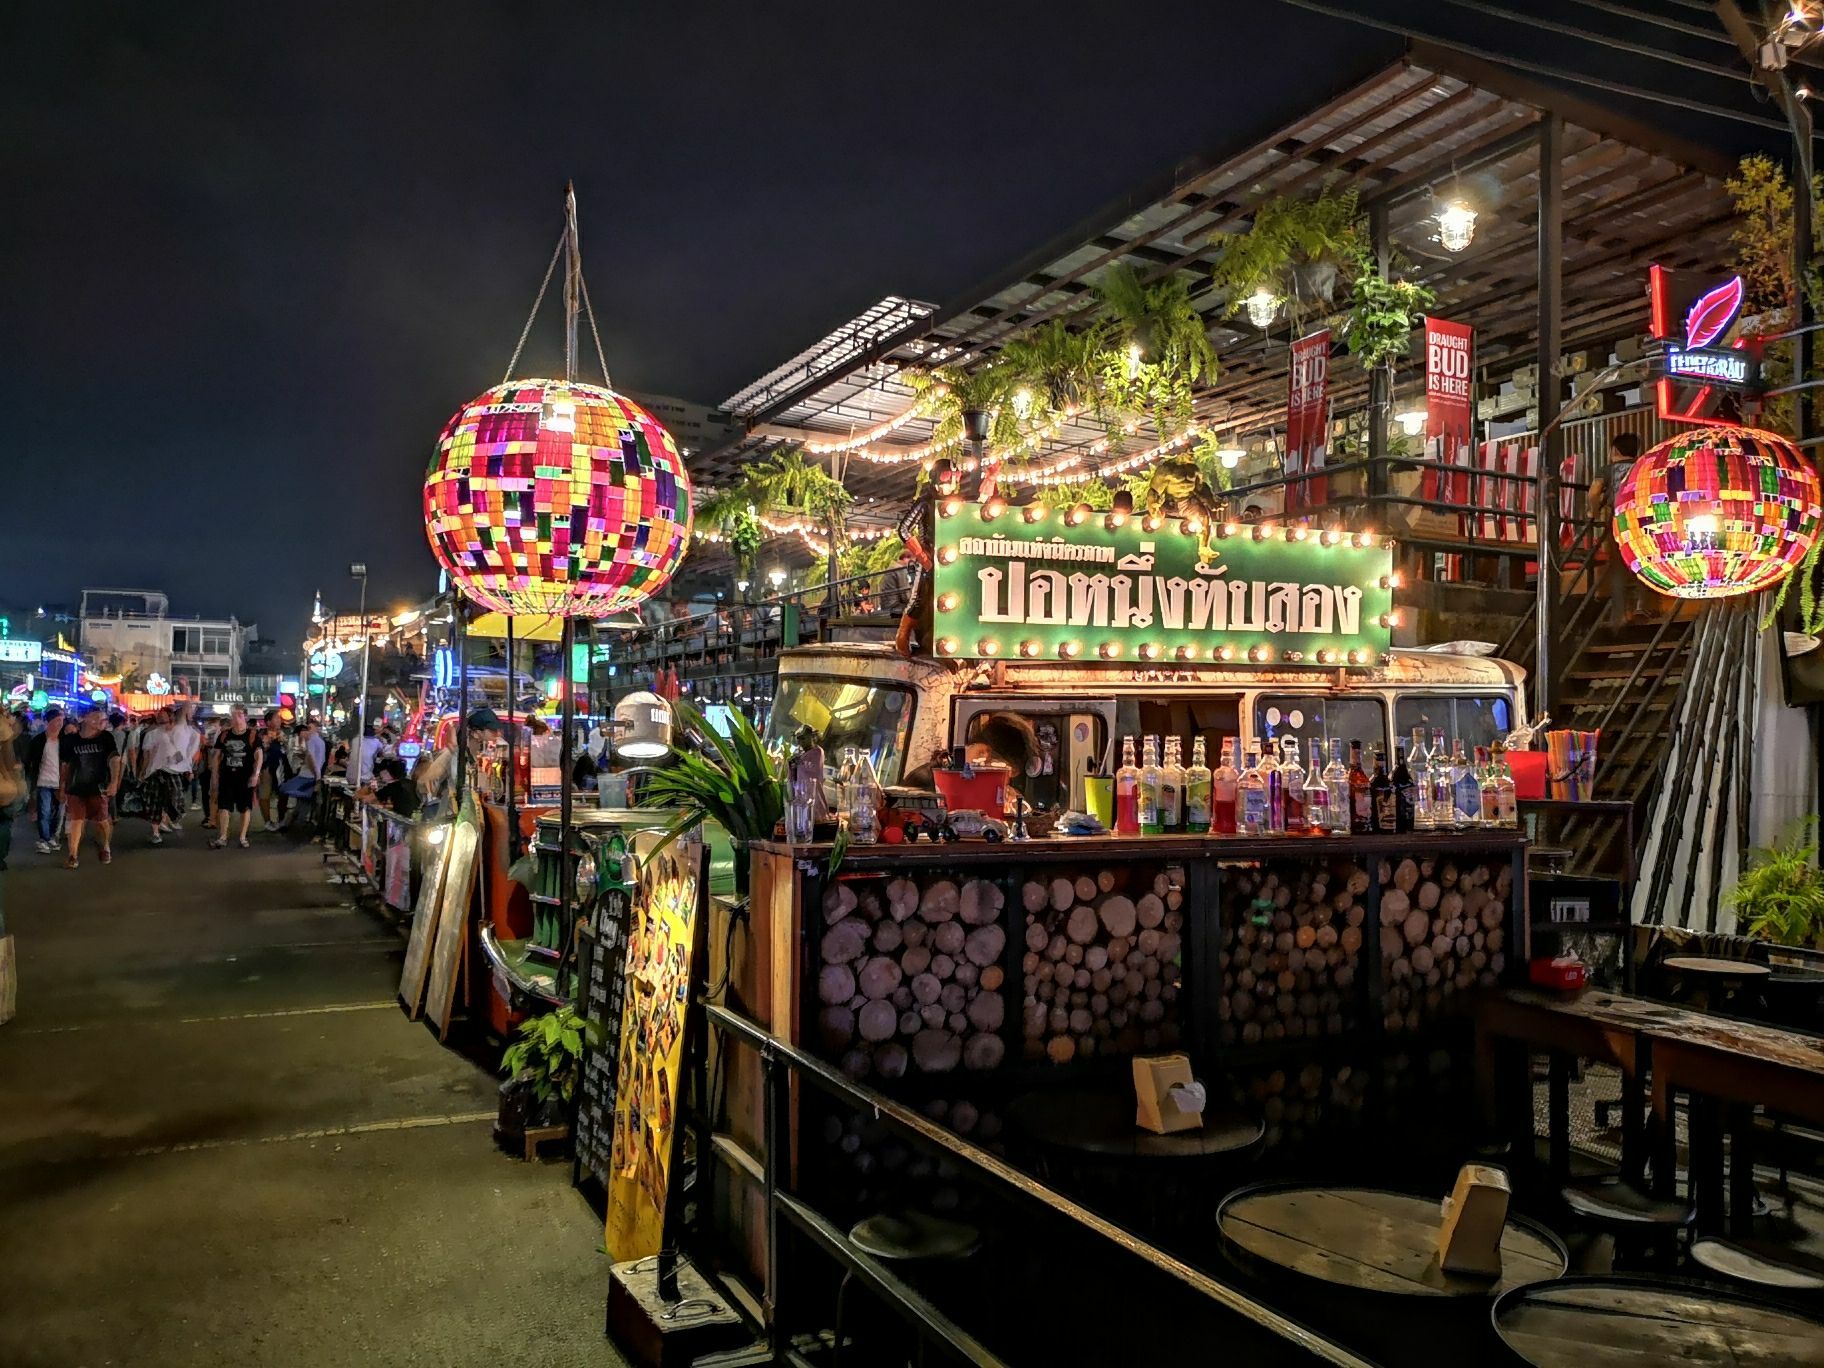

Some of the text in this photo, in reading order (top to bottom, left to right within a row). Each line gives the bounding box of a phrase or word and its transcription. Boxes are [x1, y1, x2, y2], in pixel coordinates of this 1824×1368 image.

[1293, 342, 1327, 362] DRAUGHT
[1428, 331, 1468, 351] DRAUGHT
[1292, 355, 1327, 392] BUD
[1428, 344, 1469, 380] BUD
[1290, 384, 1325, 408] IS HERE
[1428, 373, 1469, 397] IS HERE
[978, 541, 1363, 635] ปอหนึ่งทับสอง
[214, 691, 244, 703] Little
